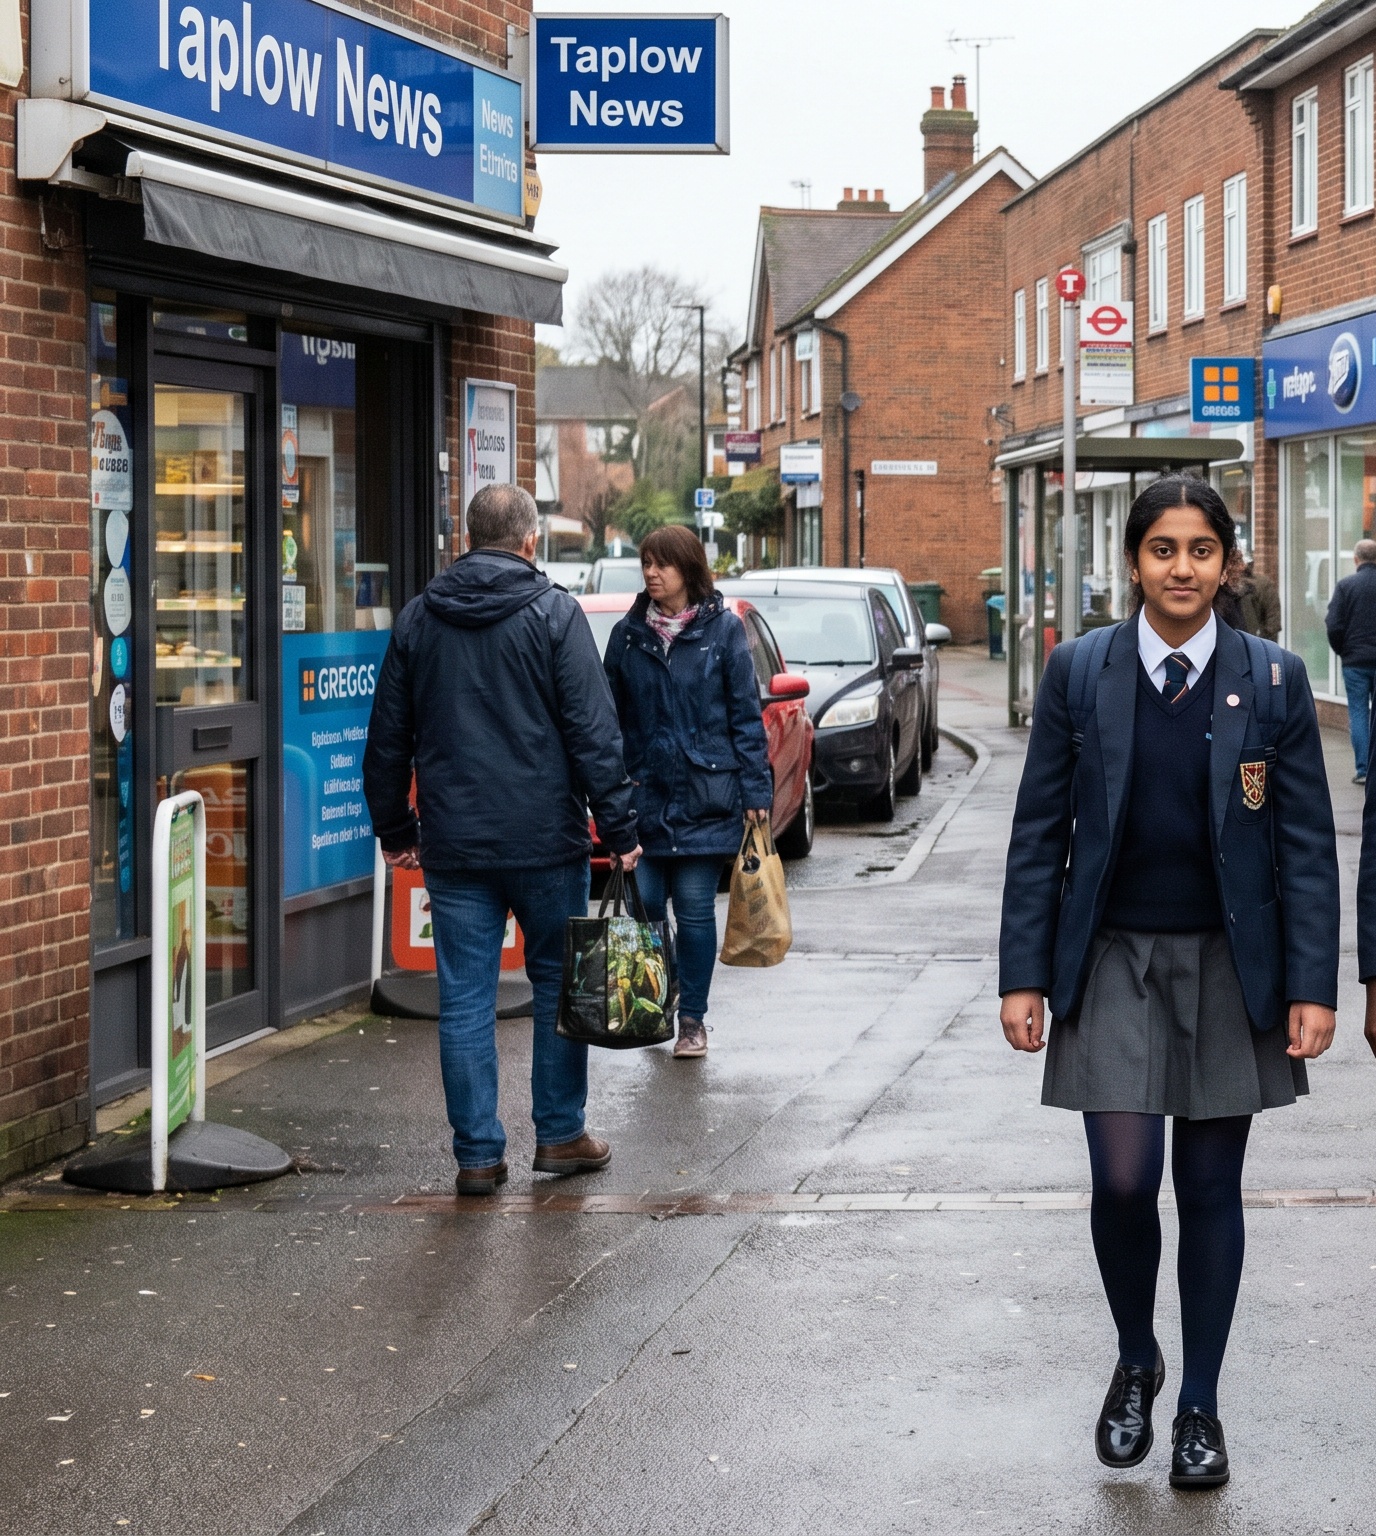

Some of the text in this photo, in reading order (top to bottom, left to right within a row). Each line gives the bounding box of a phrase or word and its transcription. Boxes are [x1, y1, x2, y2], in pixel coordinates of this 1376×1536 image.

[159, 0, 443, 157] Taplow News
[550, 36, 703, 82] Taplow
[481, 98, 514, 139] News
[569, 90, 684, 127] News
[1201, 405, 1241, 417] GREGGS
[317, 663, 376, 701] GREGGS
